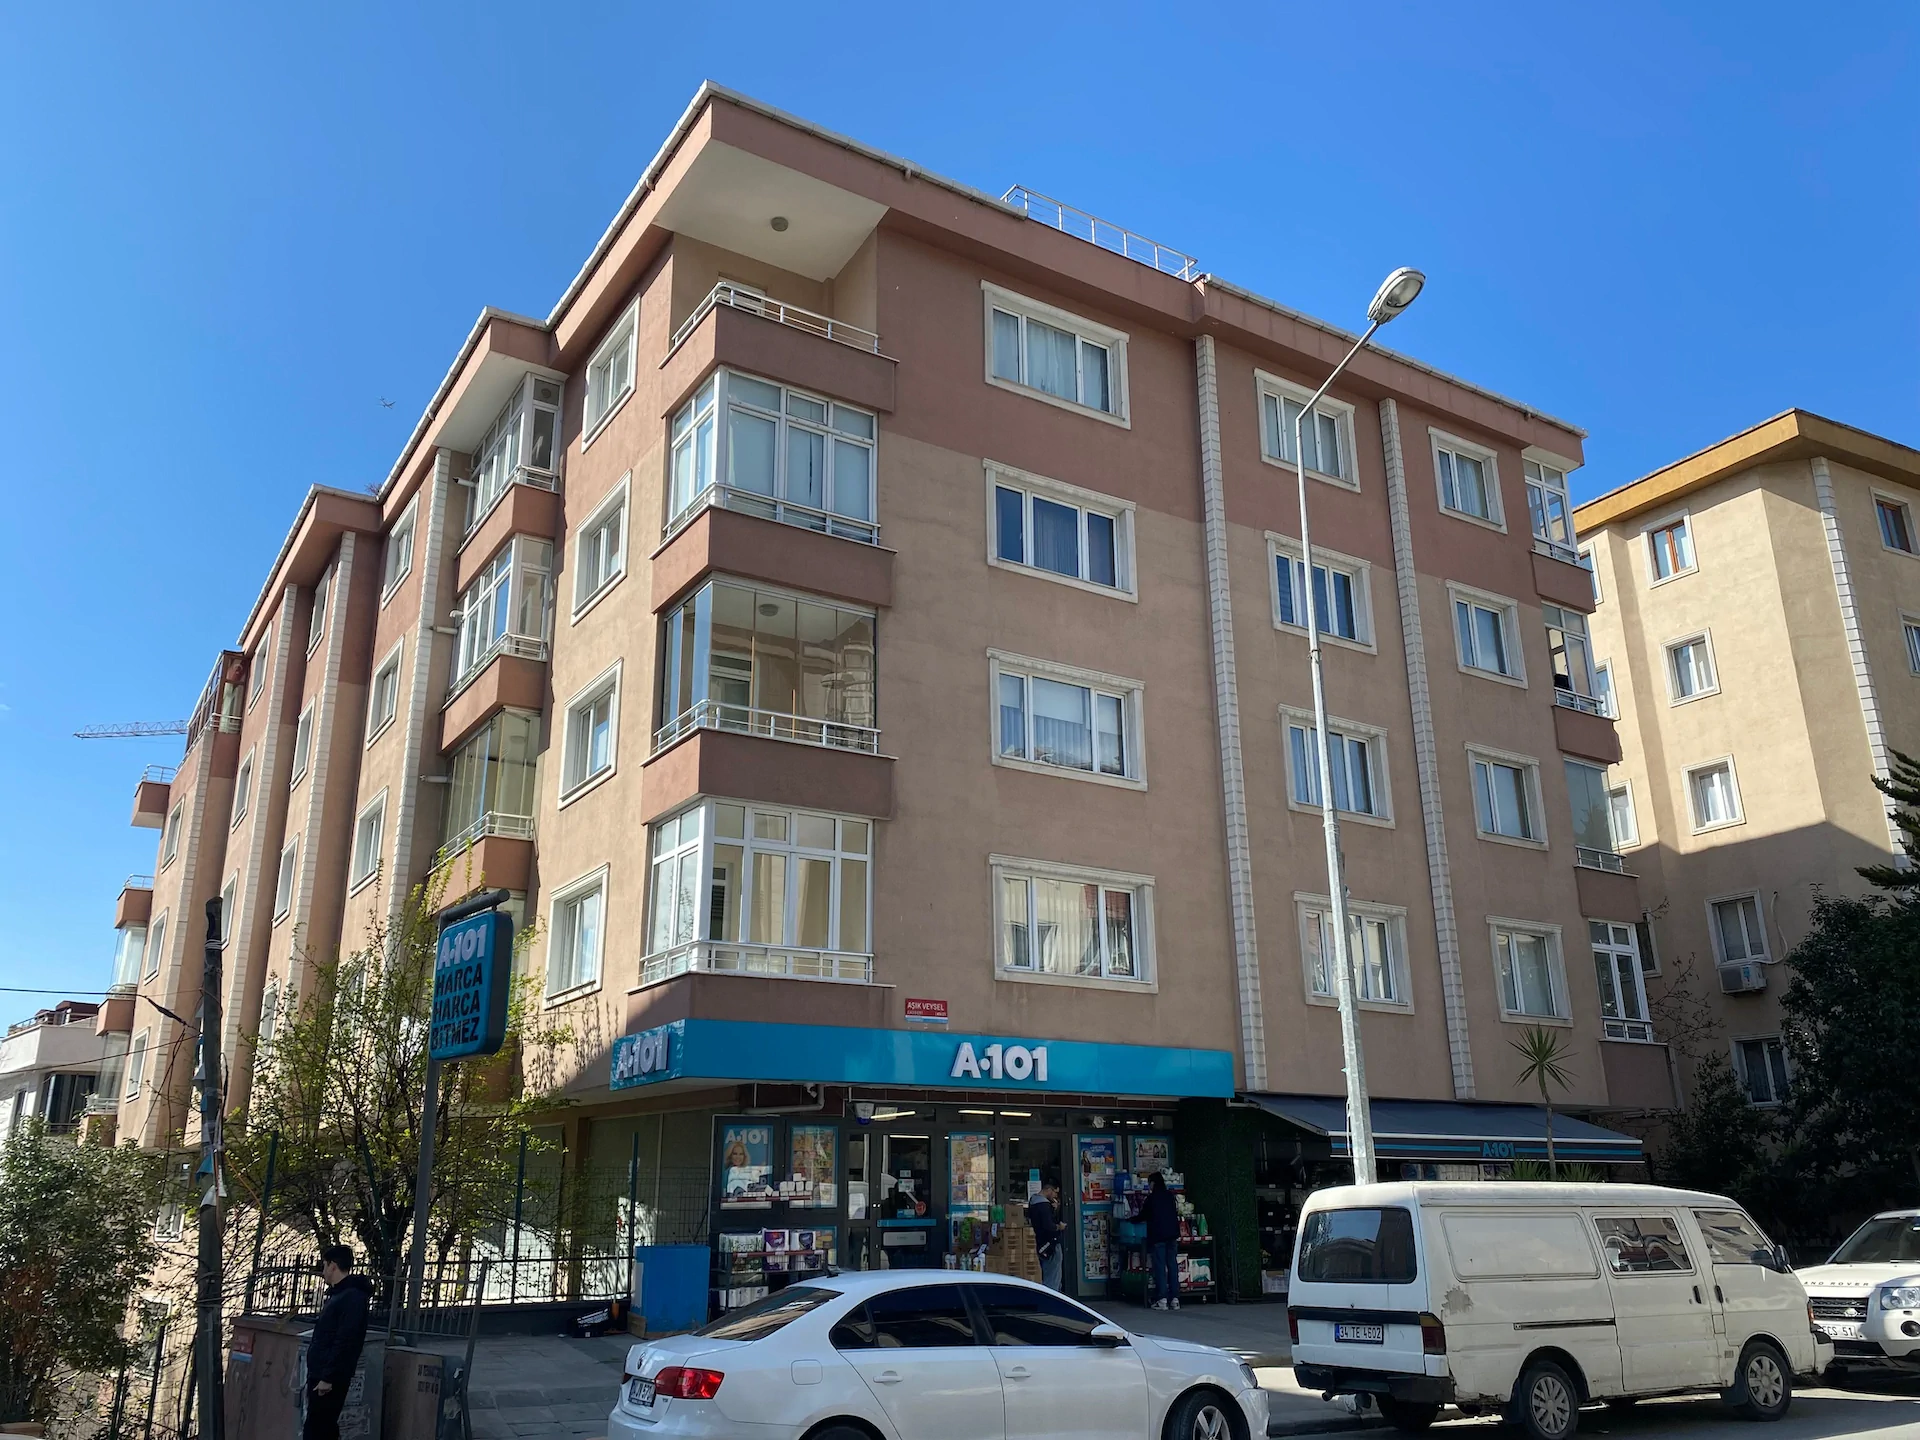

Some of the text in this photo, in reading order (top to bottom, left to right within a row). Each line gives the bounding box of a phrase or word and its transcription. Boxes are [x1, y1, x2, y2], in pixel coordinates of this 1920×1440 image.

[435, 963, 483, 998] HARCA
[433, 990, 481, 1024] HARCA
[922, 1002, 945, 1011] VEYSEL
[1339, 1326, 1348, 1338] 34
[1351, 1326, 1360, 1338] TE
[1842, 1326, 1853, 1337] 51
